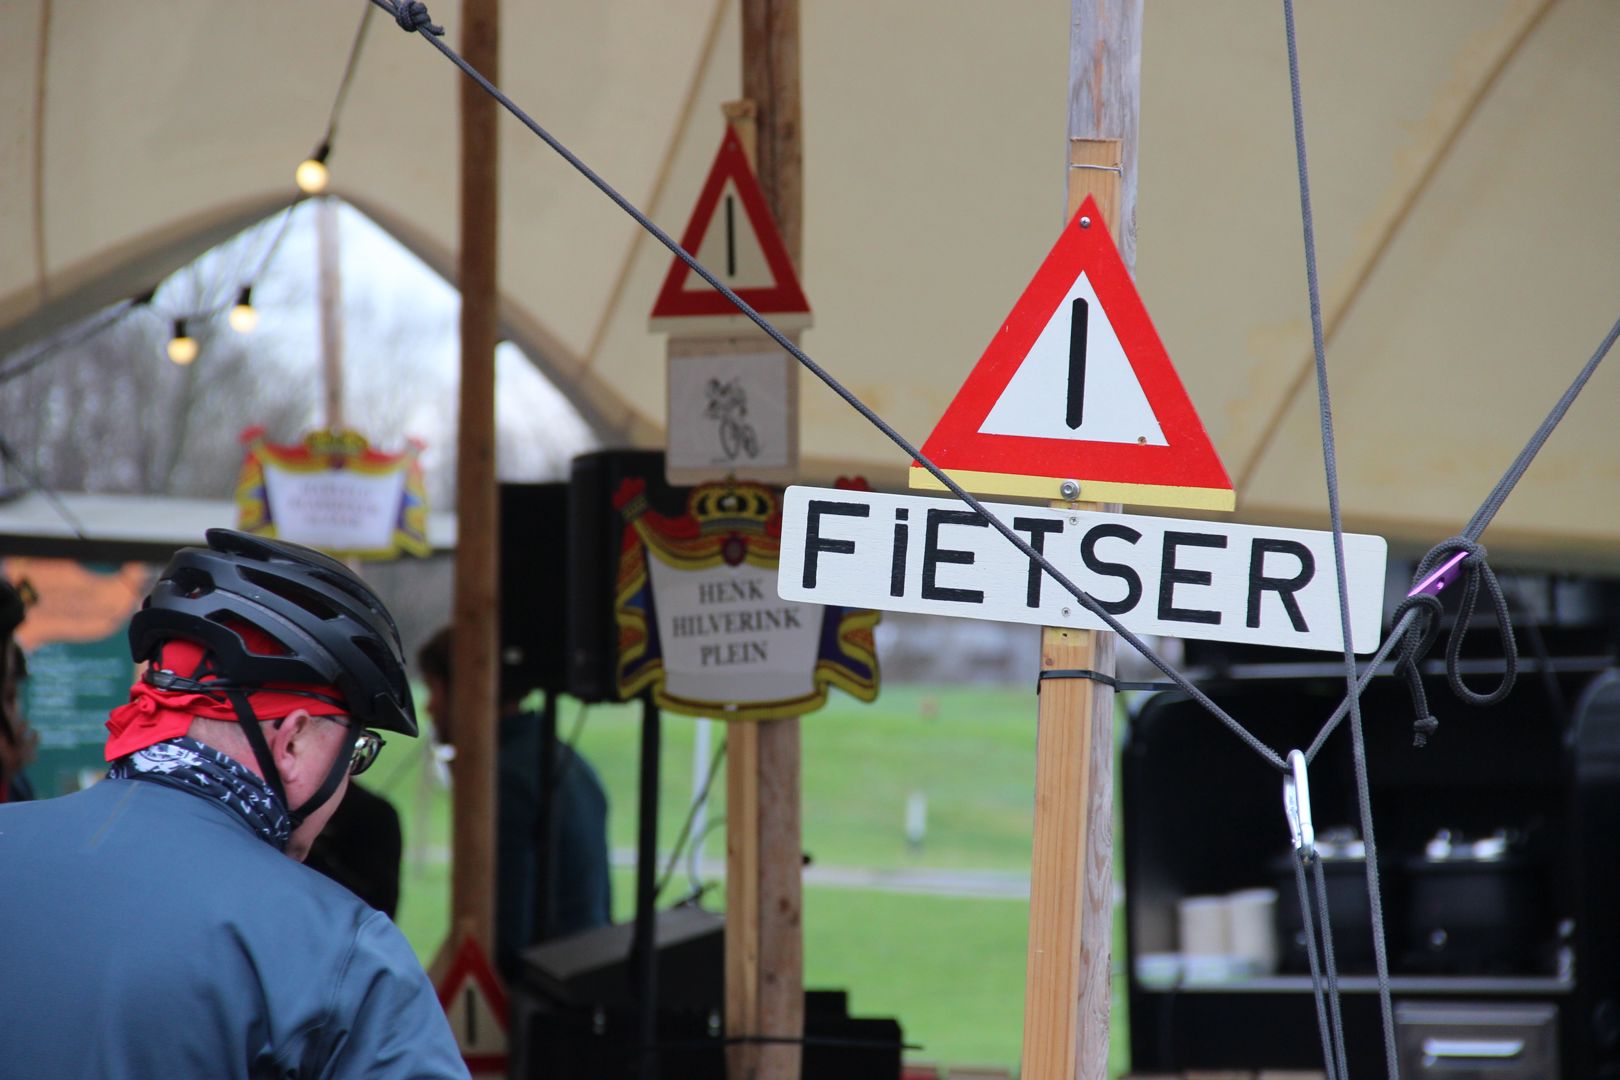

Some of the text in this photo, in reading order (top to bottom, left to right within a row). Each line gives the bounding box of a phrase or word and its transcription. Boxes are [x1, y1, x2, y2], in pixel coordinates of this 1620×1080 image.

[699, 578, 764, 605] HENK
[672, 606, 801, 638] HILVERINK
[701, 640, 768, 667] PLEIN
